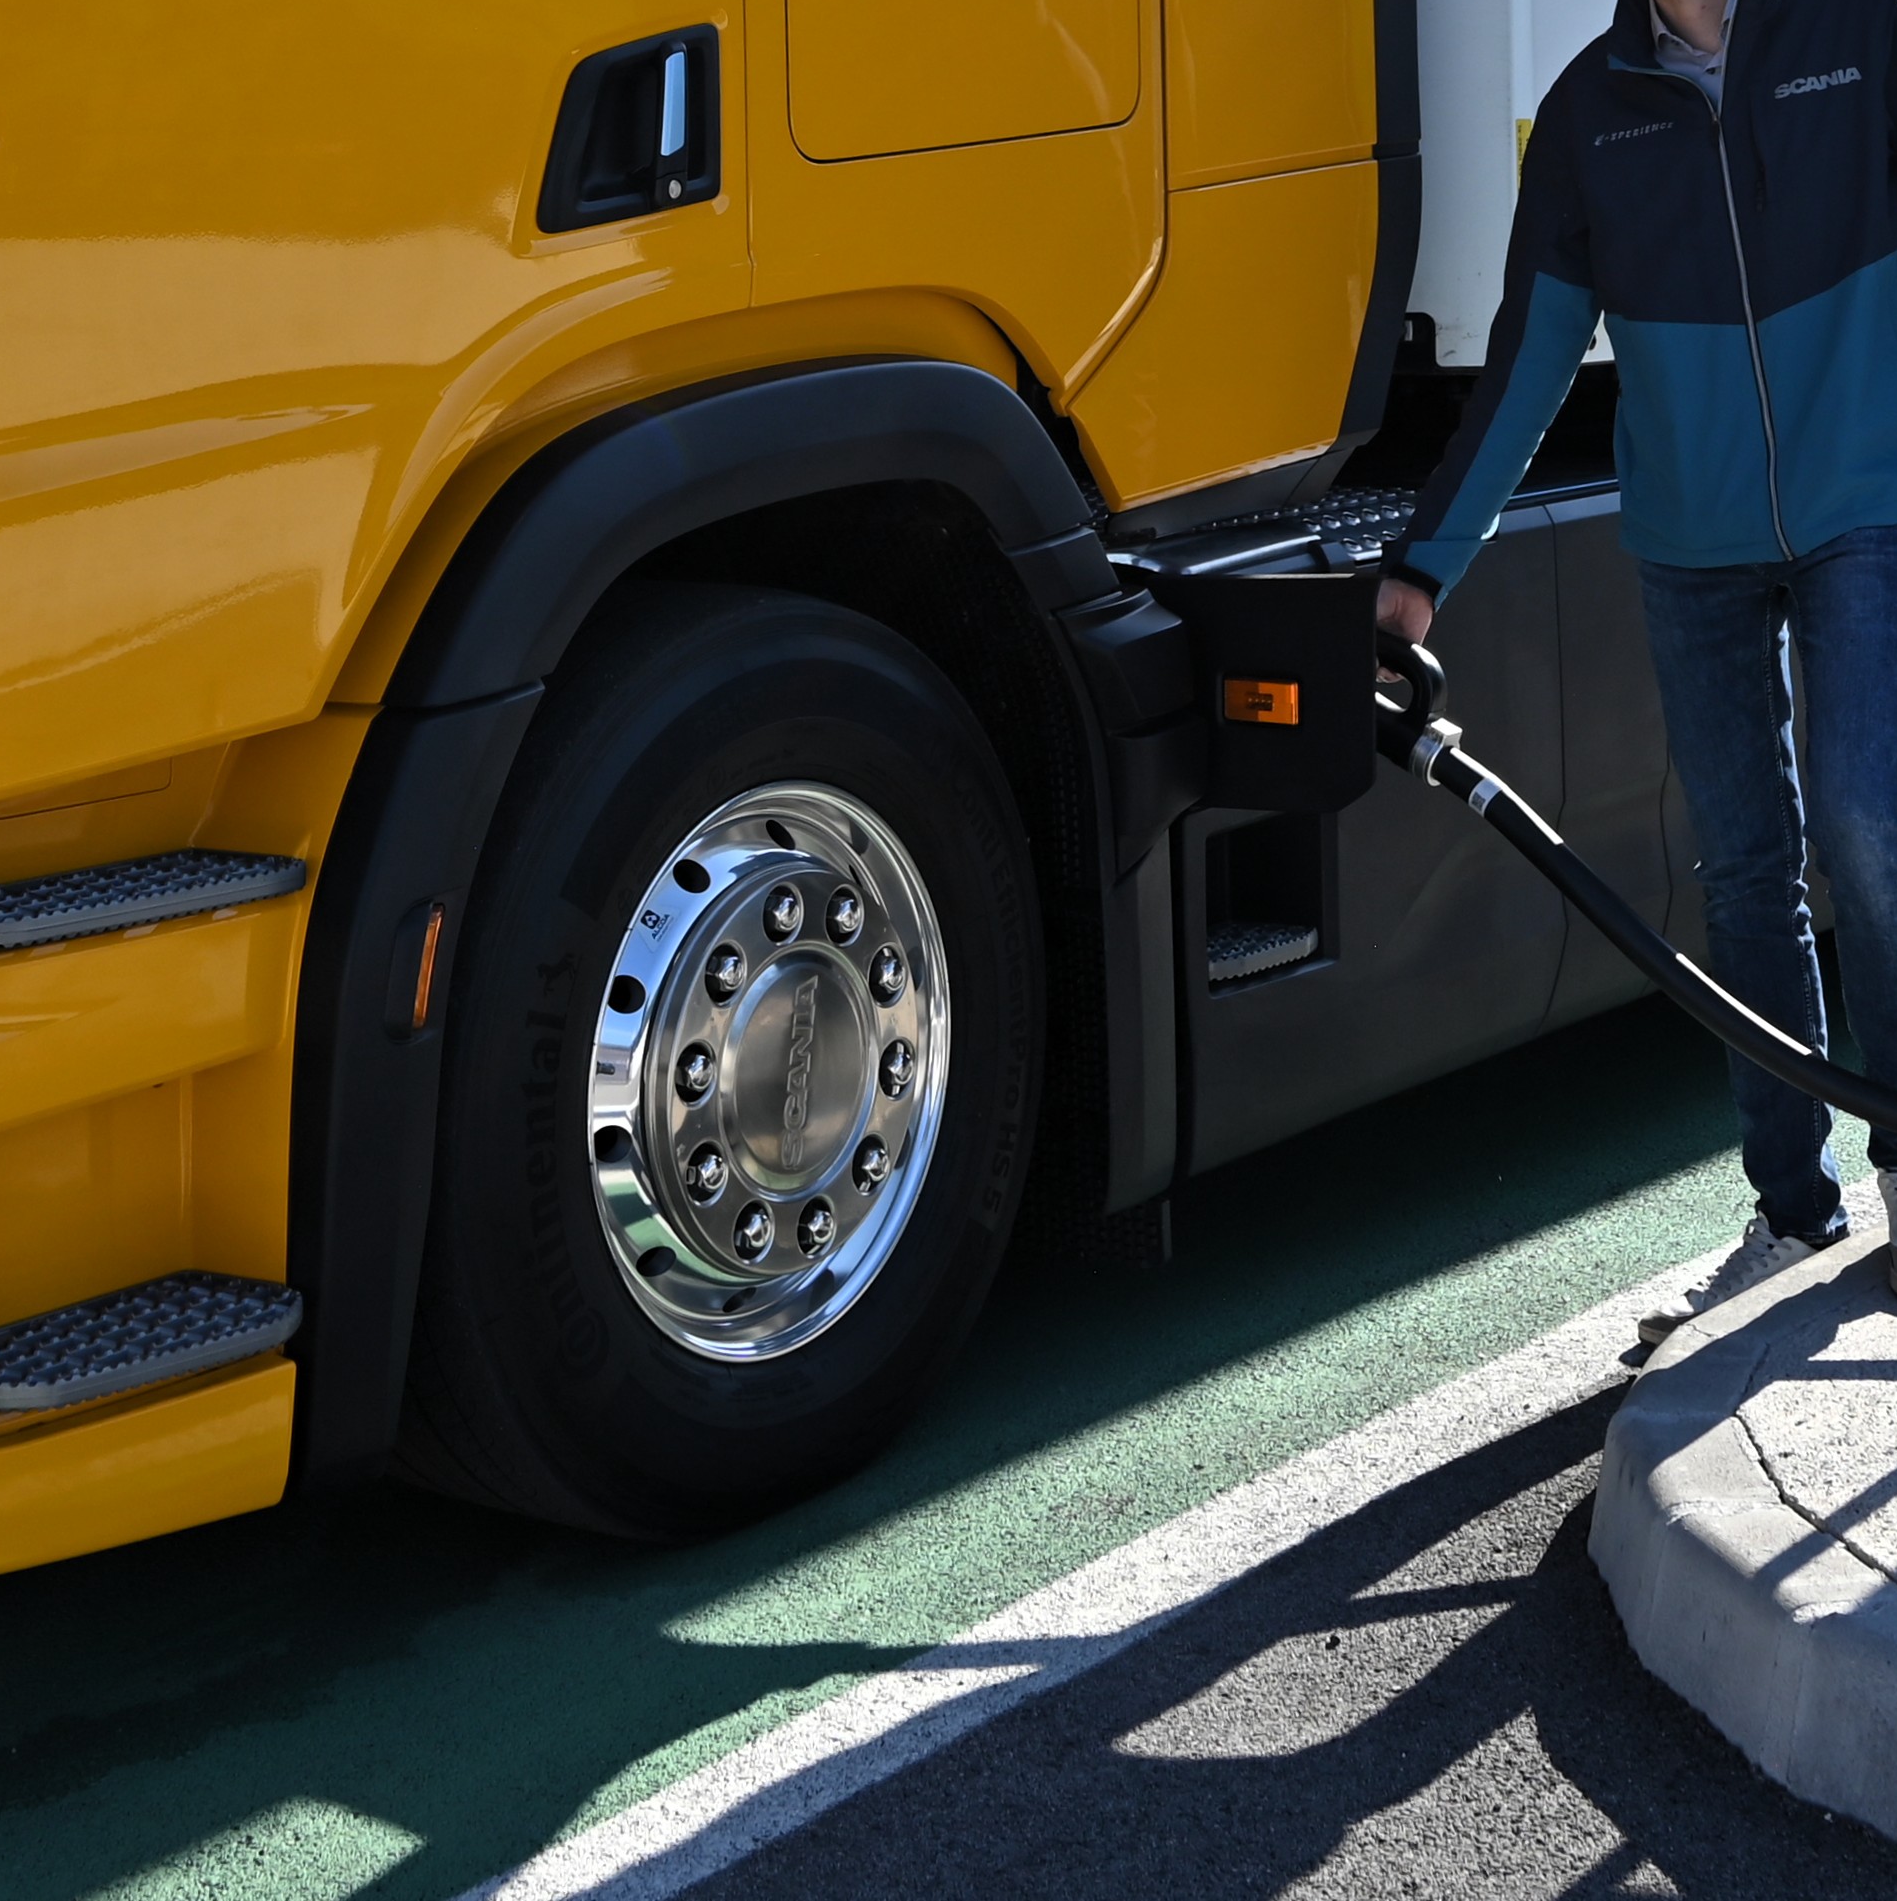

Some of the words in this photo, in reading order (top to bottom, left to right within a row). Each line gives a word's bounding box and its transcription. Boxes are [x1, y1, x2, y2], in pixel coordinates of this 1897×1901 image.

[1775, 66, 1862, 99] SCANIA
[781, 975, 818, 1169] SCANIA
[521, 1009, 610, 1382] Continental
[981, 1186, 1001, 1214] 5
